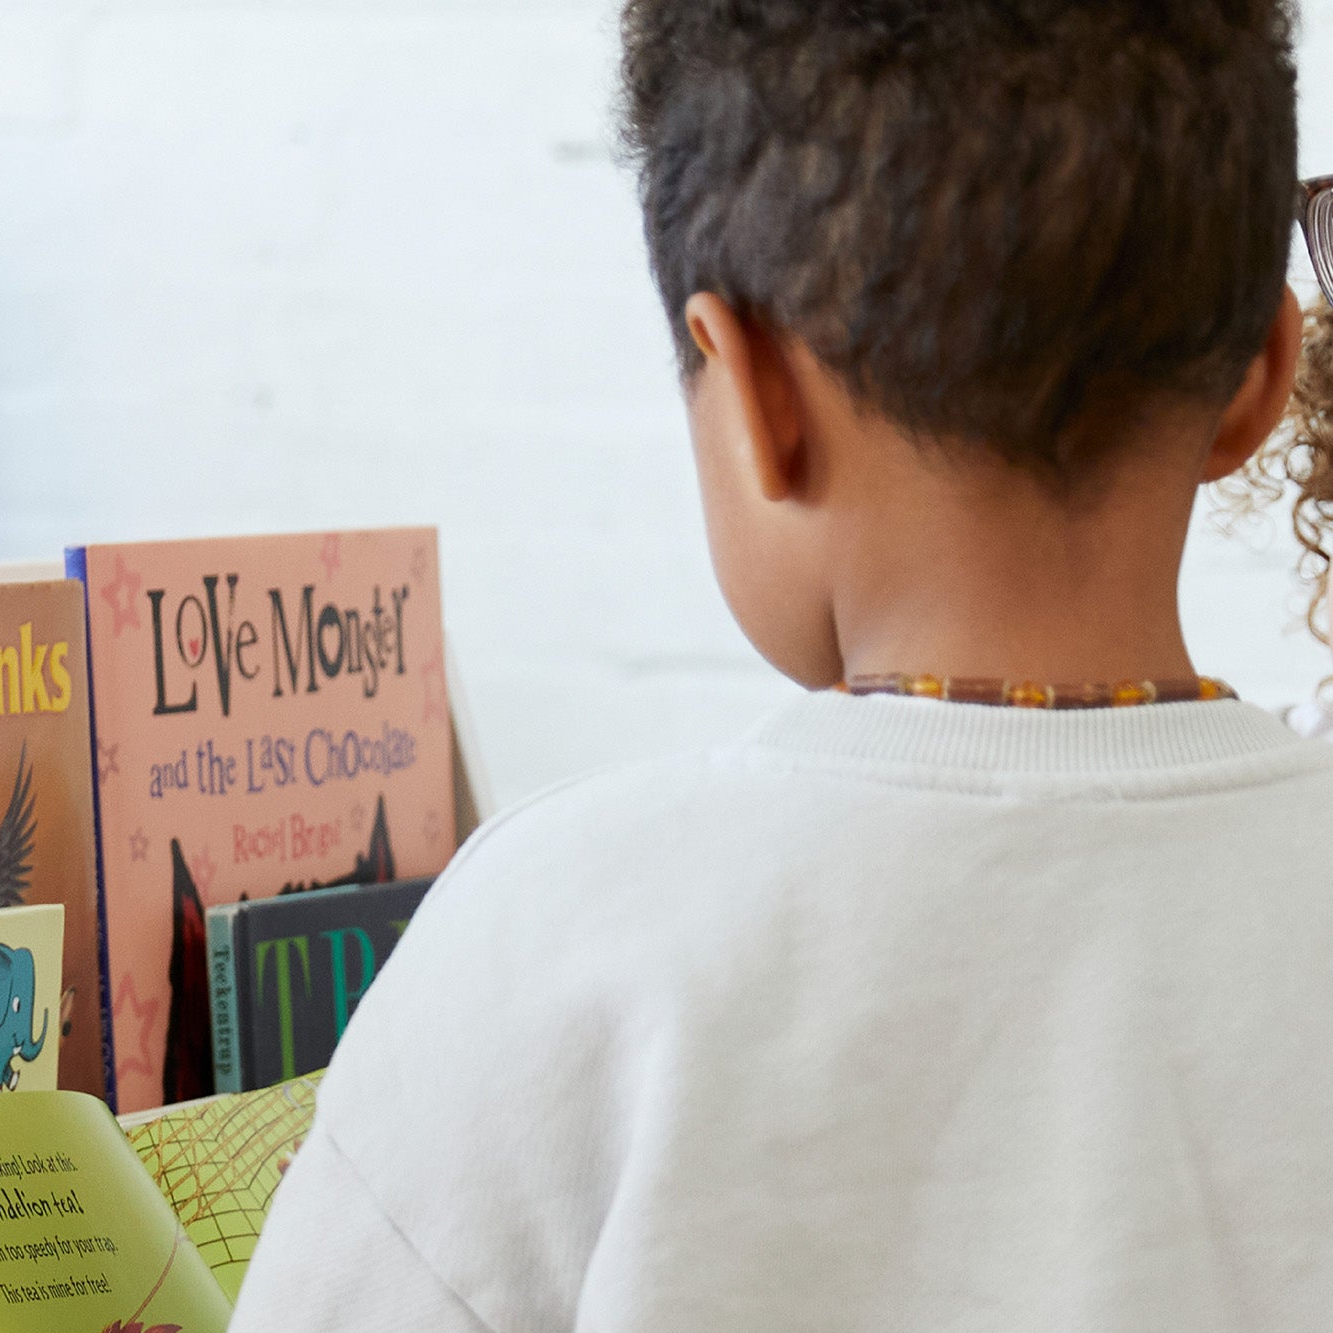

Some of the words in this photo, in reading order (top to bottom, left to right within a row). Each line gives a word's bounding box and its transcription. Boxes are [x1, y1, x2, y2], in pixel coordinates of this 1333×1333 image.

[269, 584, 410, 699] Monster
[150, 750, 188, 798] and
[196, 739, 236, 795] the
[247, 734, 296, 793] Last
[19, 1153, 46, 1175] Look
[47, 1156, 60, 1173] at
[52, 1189, 85, 1218] tea!
[6, 1242, 25, 1261] too
[24, 1237, 60, 1264] speedy
[55, 1235, 74, 1256] for
[72, 1237, 96, 1259] your
[21, 1281, 41, 1302] tea
[38, 1281, 50, 1300] is
[50, 1279, 75, 1298] mine
[69, 1276, 87, 1296] for
[85, 1273, 112, 1295] free!
